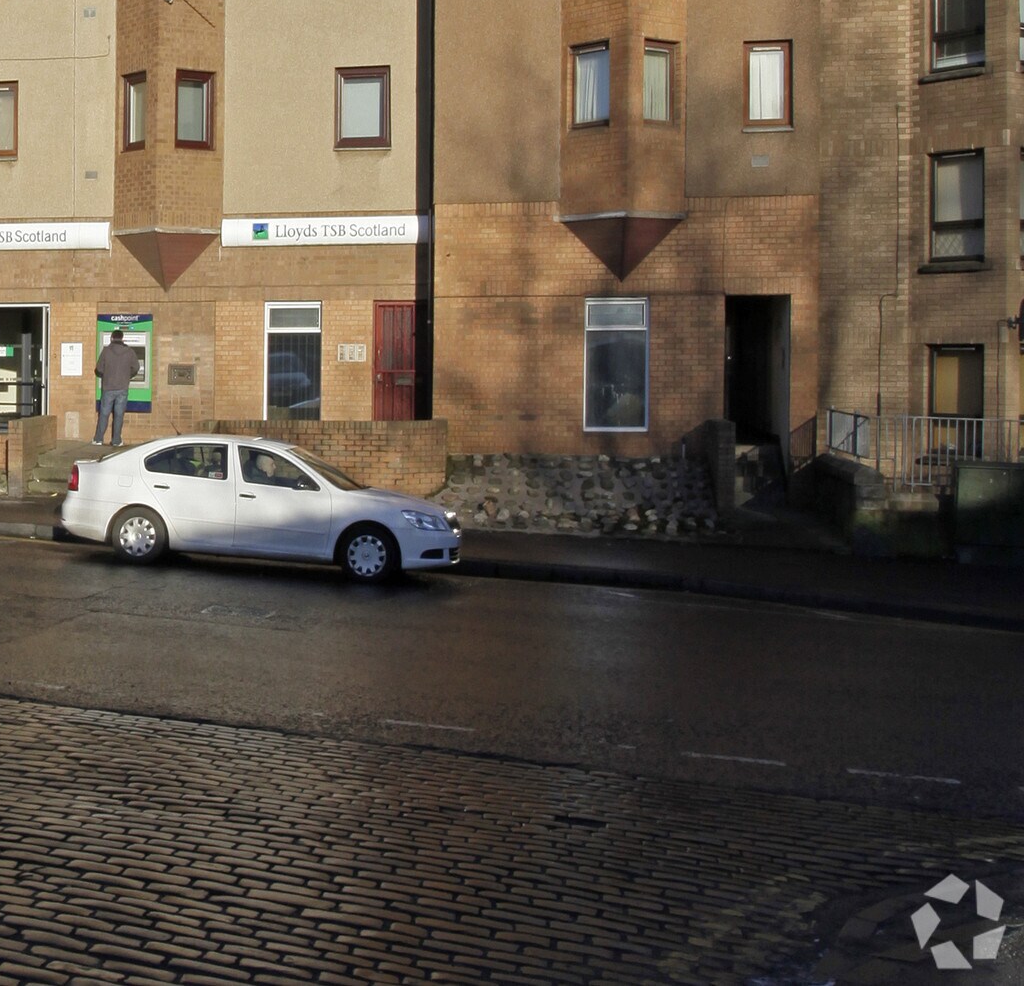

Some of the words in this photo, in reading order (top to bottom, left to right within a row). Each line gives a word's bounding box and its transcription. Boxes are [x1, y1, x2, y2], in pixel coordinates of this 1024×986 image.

[14, 230, 67, 243] Scotland
[275, 224, 318, 241] Lloyds
[321, 224, 346, 237] TSB
[349, 223, 406, 237] Scotland
[110, 314, 140, 322] cashpoint
